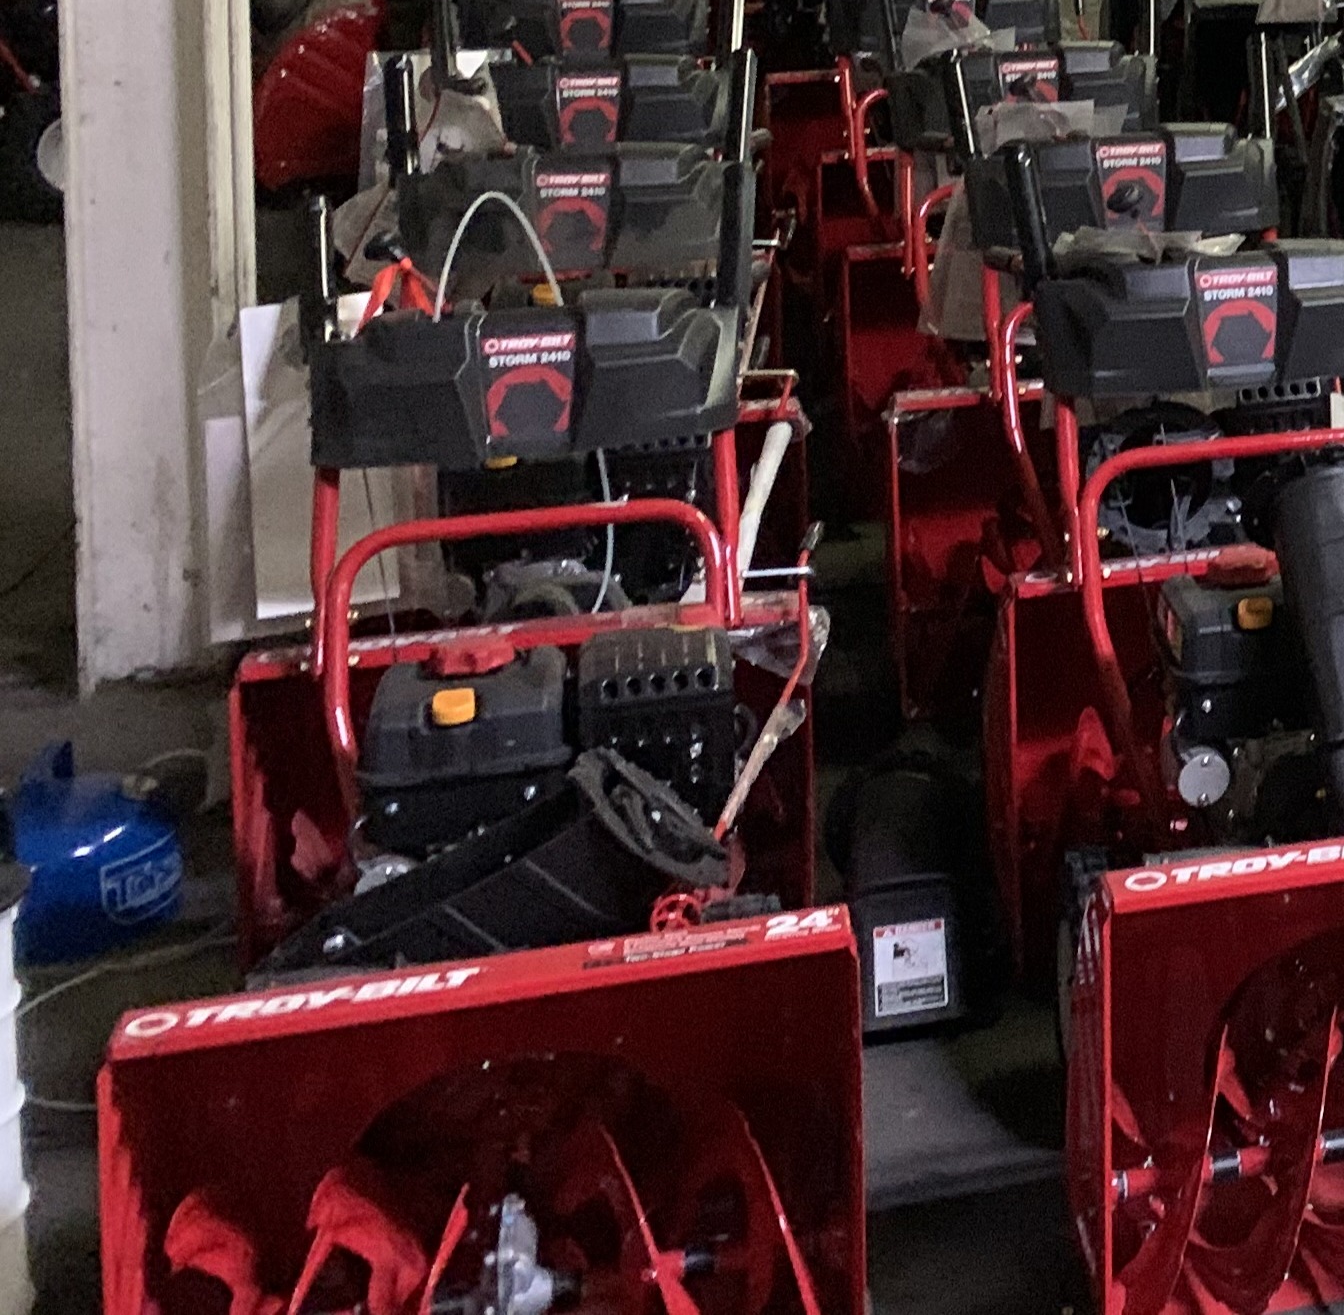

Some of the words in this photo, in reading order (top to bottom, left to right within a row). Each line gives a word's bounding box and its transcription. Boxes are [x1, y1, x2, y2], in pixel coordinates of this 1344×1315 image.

[1212, 270, 1275, 286] TROY-BILT
[1203, 288, 1246, 301] STORM
[1247, 286, 1274, 298] 2410
[500, 333, 574, 352] TROY-BILT
[488, 353, 538, 369] STORM
[540, 350, 571, 365] 2410
[183, 966, 482, 1028] TROY-BILT
